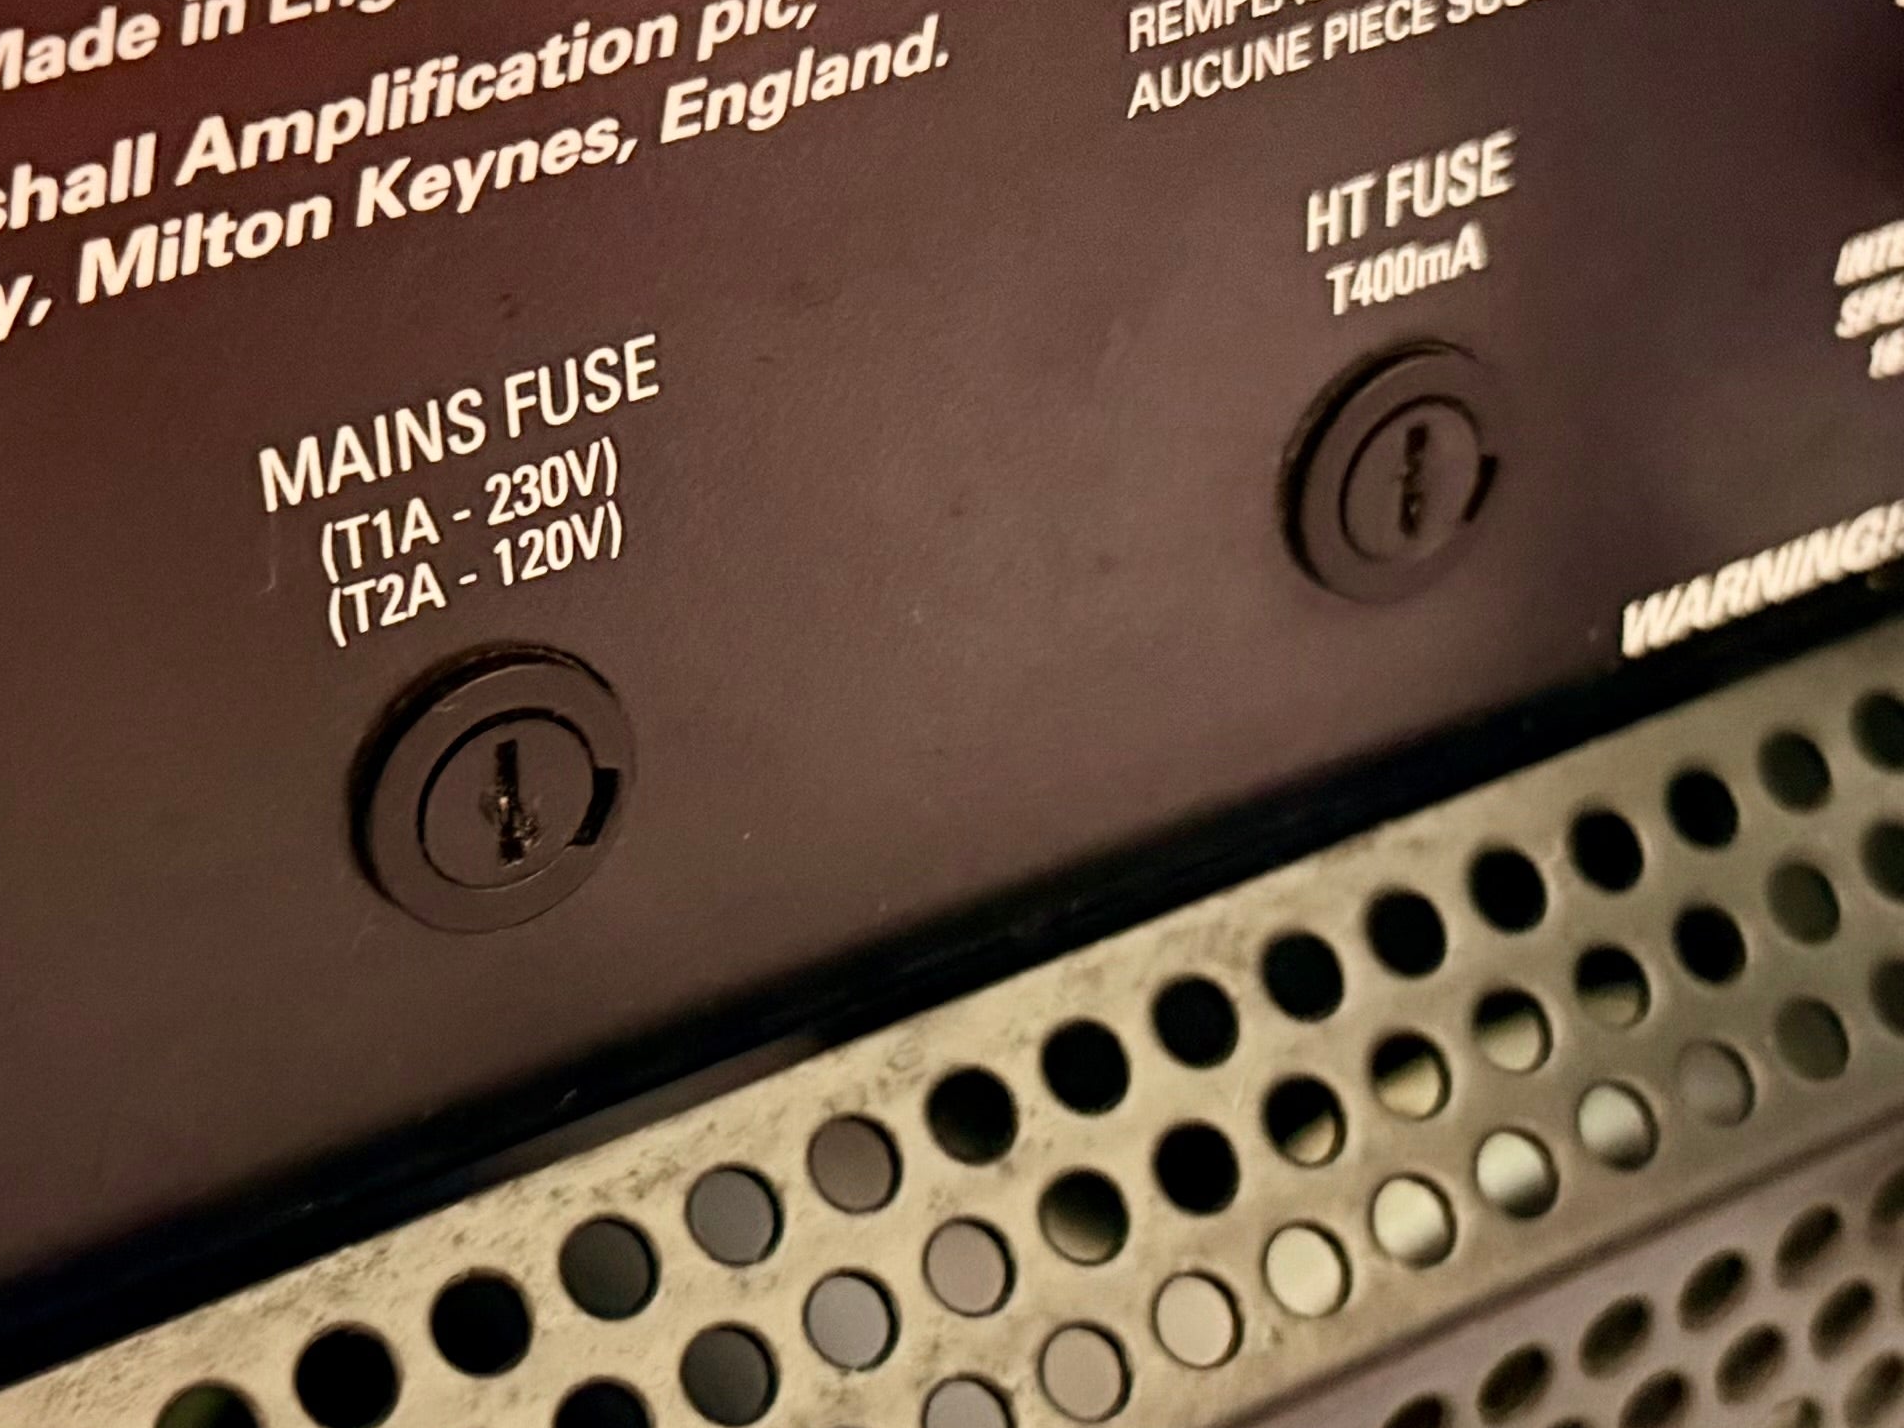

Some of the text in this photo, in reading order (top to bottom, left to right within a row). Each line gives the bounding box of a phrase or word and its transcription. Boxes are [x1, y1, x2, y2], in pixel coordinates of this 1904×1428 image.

[174, 12, 680, 187] Amplification
[1126, 27, 1314, 120] AUCUNE
[75, 193, 333, 306] Milton
[354, 116, 639, 229] Keynes,
[658, 11, 951, 145] England.
[1306, 127, 1518, 253] HT FUSE
[1324, 220, 1490, 315] T400mA
[258, 333, 661, 513] MAINS FUSE
[320, 435, 619, 584] (T1A - 230V)
[327, 499, 624, 648] (T2A - 120V)
